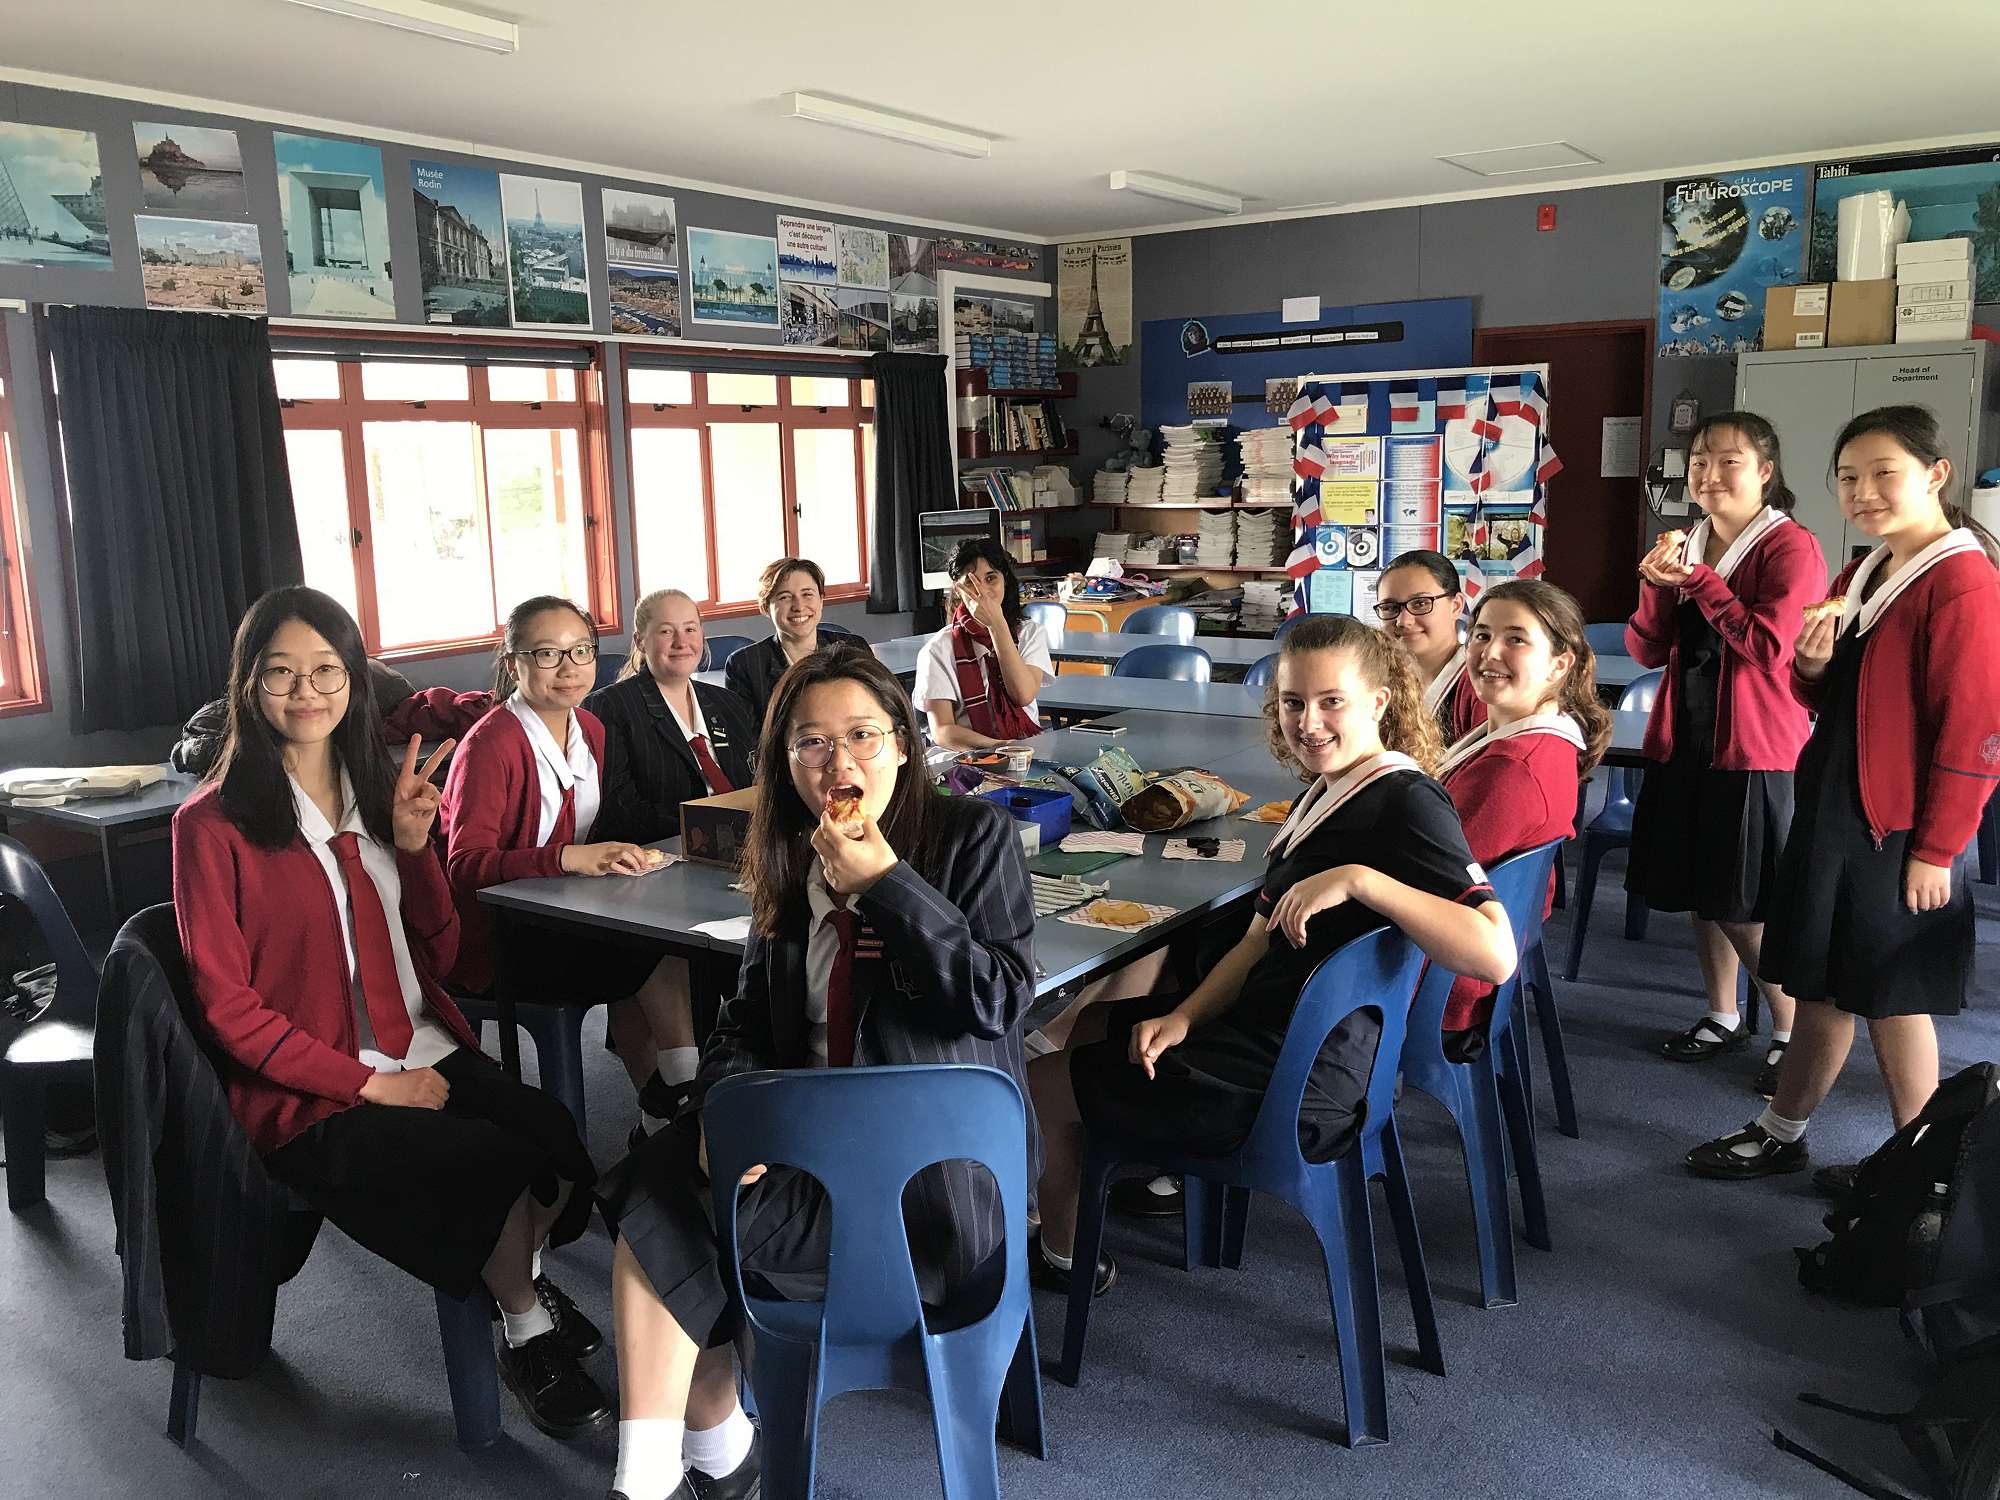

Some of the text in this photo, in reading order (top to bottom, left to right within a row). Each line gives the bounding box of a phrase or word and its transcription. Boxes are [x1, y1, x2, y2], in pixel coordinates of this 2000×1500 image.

[416, 167, 444, 179] Musée
[1817, 164, 1850, 179] Tahiti
[418, 178, 442, 189] Rodin
[1675, 178, 1793, 204] FUTUROSCOPE
[780, 218, 806, 230] Apprendre
[796, 242, 809, 250] autre
[1076, 246, 1091, 255] Petit
[1097, 243, 1122, 253] Parisien
[1892, 374, 1938, 382] Department
